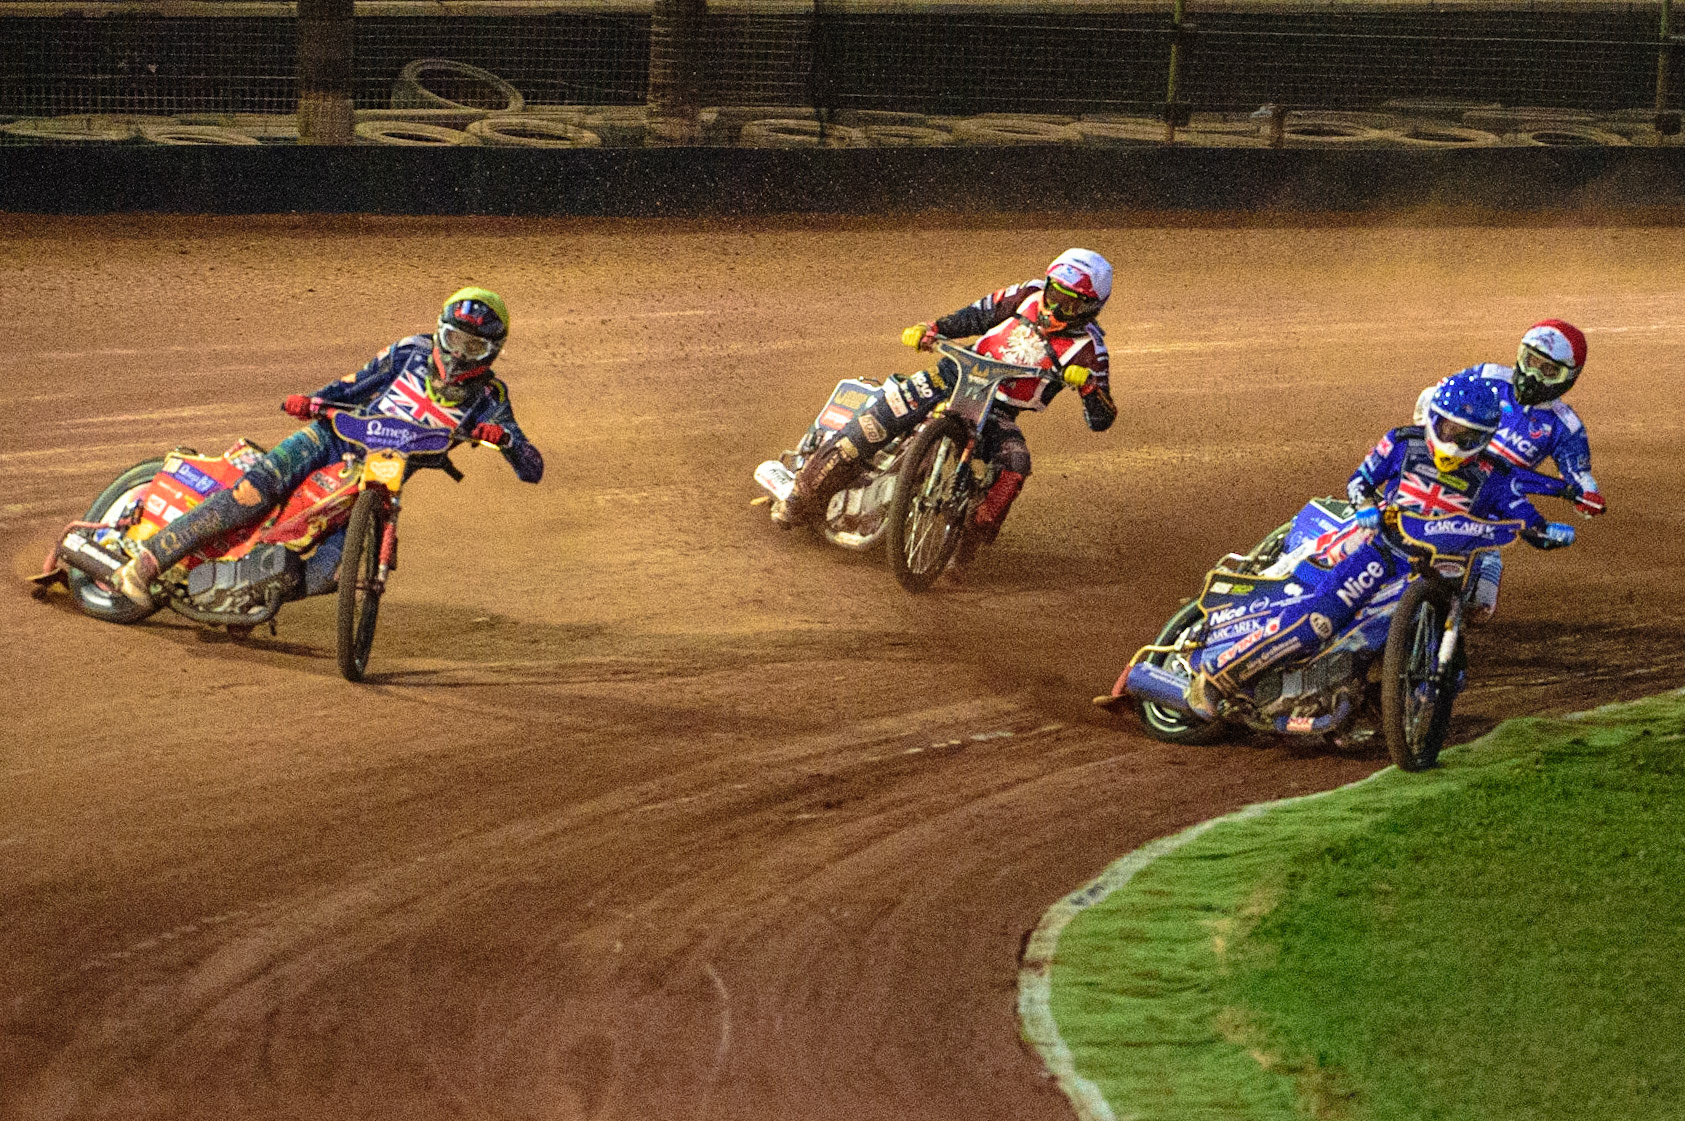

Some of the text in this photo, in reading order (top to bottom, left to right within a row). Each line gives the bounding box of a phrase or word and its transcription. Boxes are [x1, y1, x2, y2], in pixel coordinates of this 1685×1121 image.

[1496, 427, 1539, 457] ANCE
[1336, 561, 1384, 608] Nice
[1210, 606, 1246, 626] Nice
